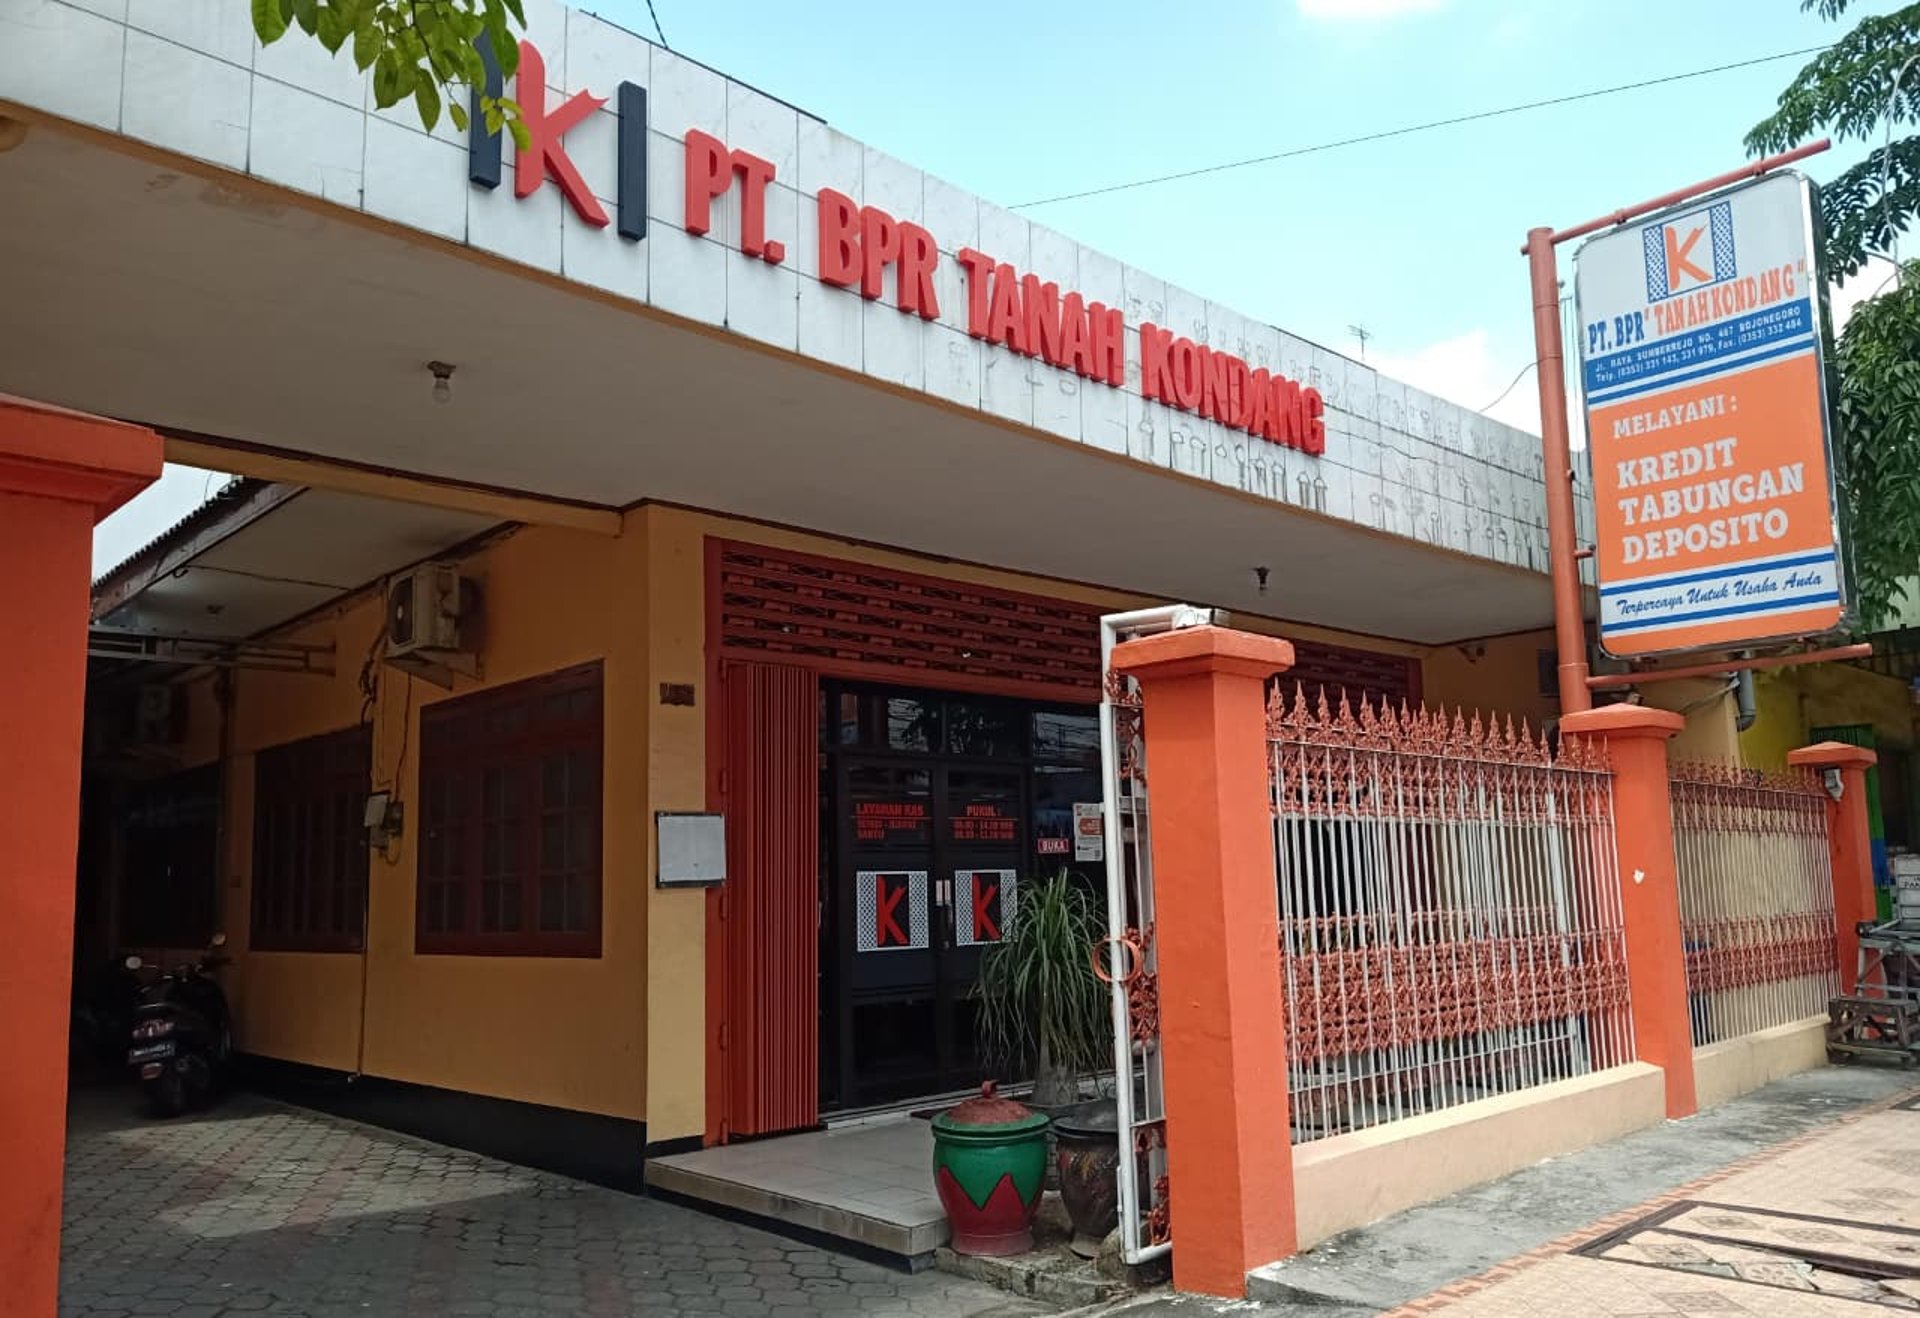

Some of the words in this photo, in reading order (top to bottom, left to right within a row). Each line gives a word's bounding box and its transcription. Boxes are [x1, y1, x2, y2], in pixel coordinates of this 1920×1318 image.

[684, 128, 785, 265] PT.
[817, 186, 941, 321] BPR
[958, 246, 1124, 388] TANAH
[1139, 321, 1326, 457] KONDANG
[1587, 320, 1613, 355] PT.
[1613, 310, 1645, 347] BPR
[1610, 355, 1633, 368] RAYA
[1739, 305, 1801, 332] BOJONEGORO
[1612, 394, 1726, 439] MELAYANI
[1616, 437, 1738, 490] KREDIT
[1617, 462, 1805, 526] TABUNGAN
[1621, 507, 1789, 565] DEPOSITO
[1616, 594, 1683, 617] Terpercaya
[1686, 583, 1730, 604] Untuk
[1733, 577, 1778, 597] Usaha
[1781, 570, 1822, 591] Anda
